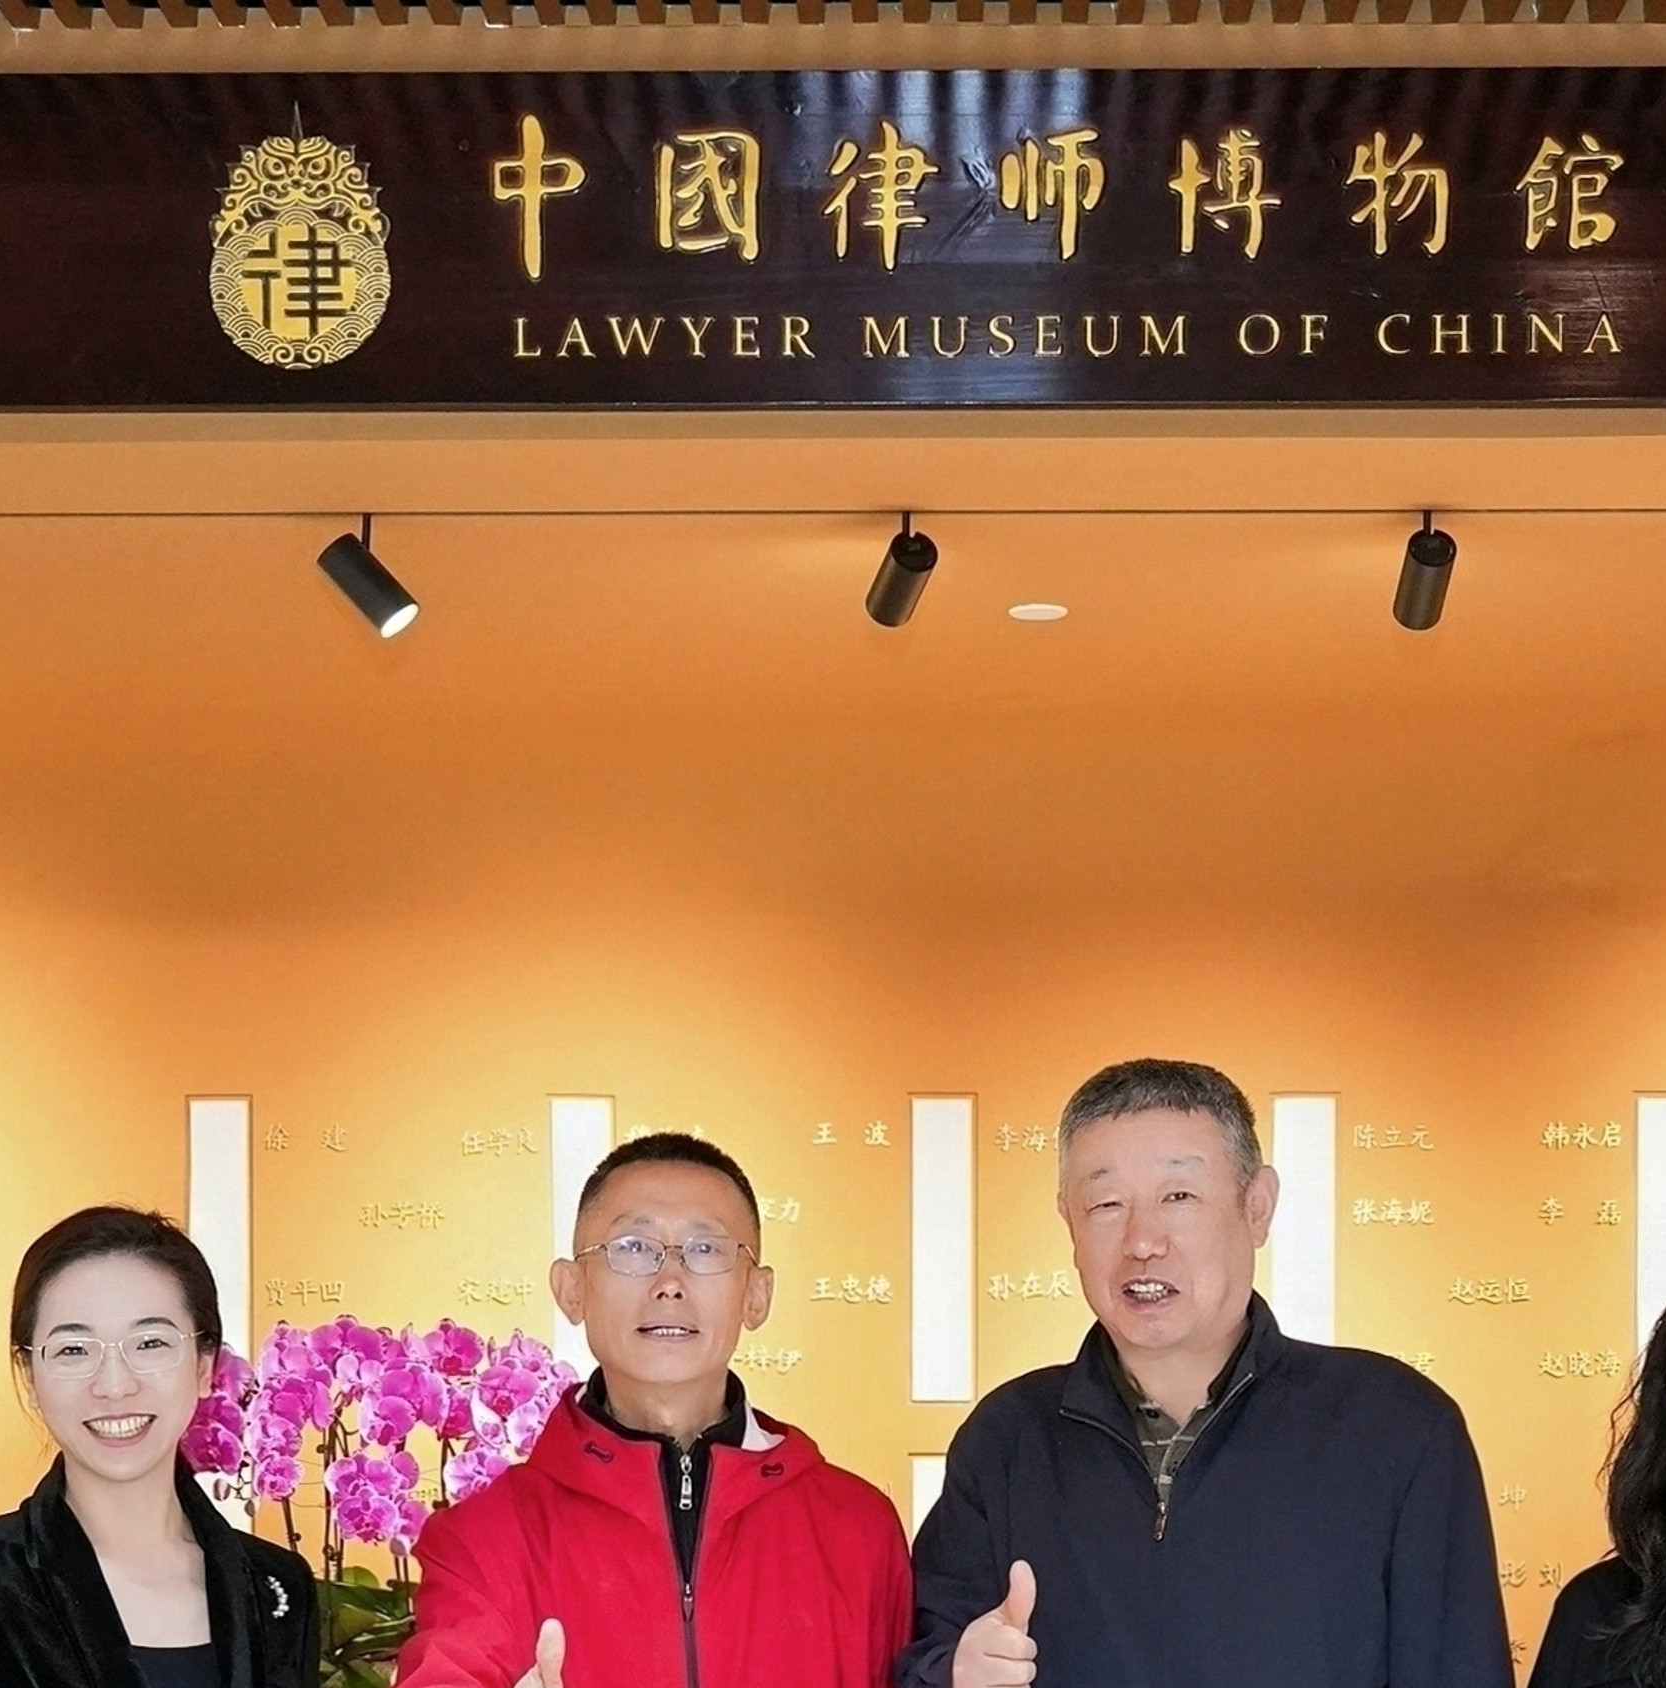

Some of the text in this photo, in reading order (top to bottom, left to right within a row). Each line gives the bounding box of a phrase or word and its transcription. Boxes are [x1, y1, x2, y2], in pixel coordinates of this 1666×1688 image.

[513, 313, 1624, 358] LAWYER MUSEUM OF CHINA
[810, 1274, 893, 1304] 王忠德
